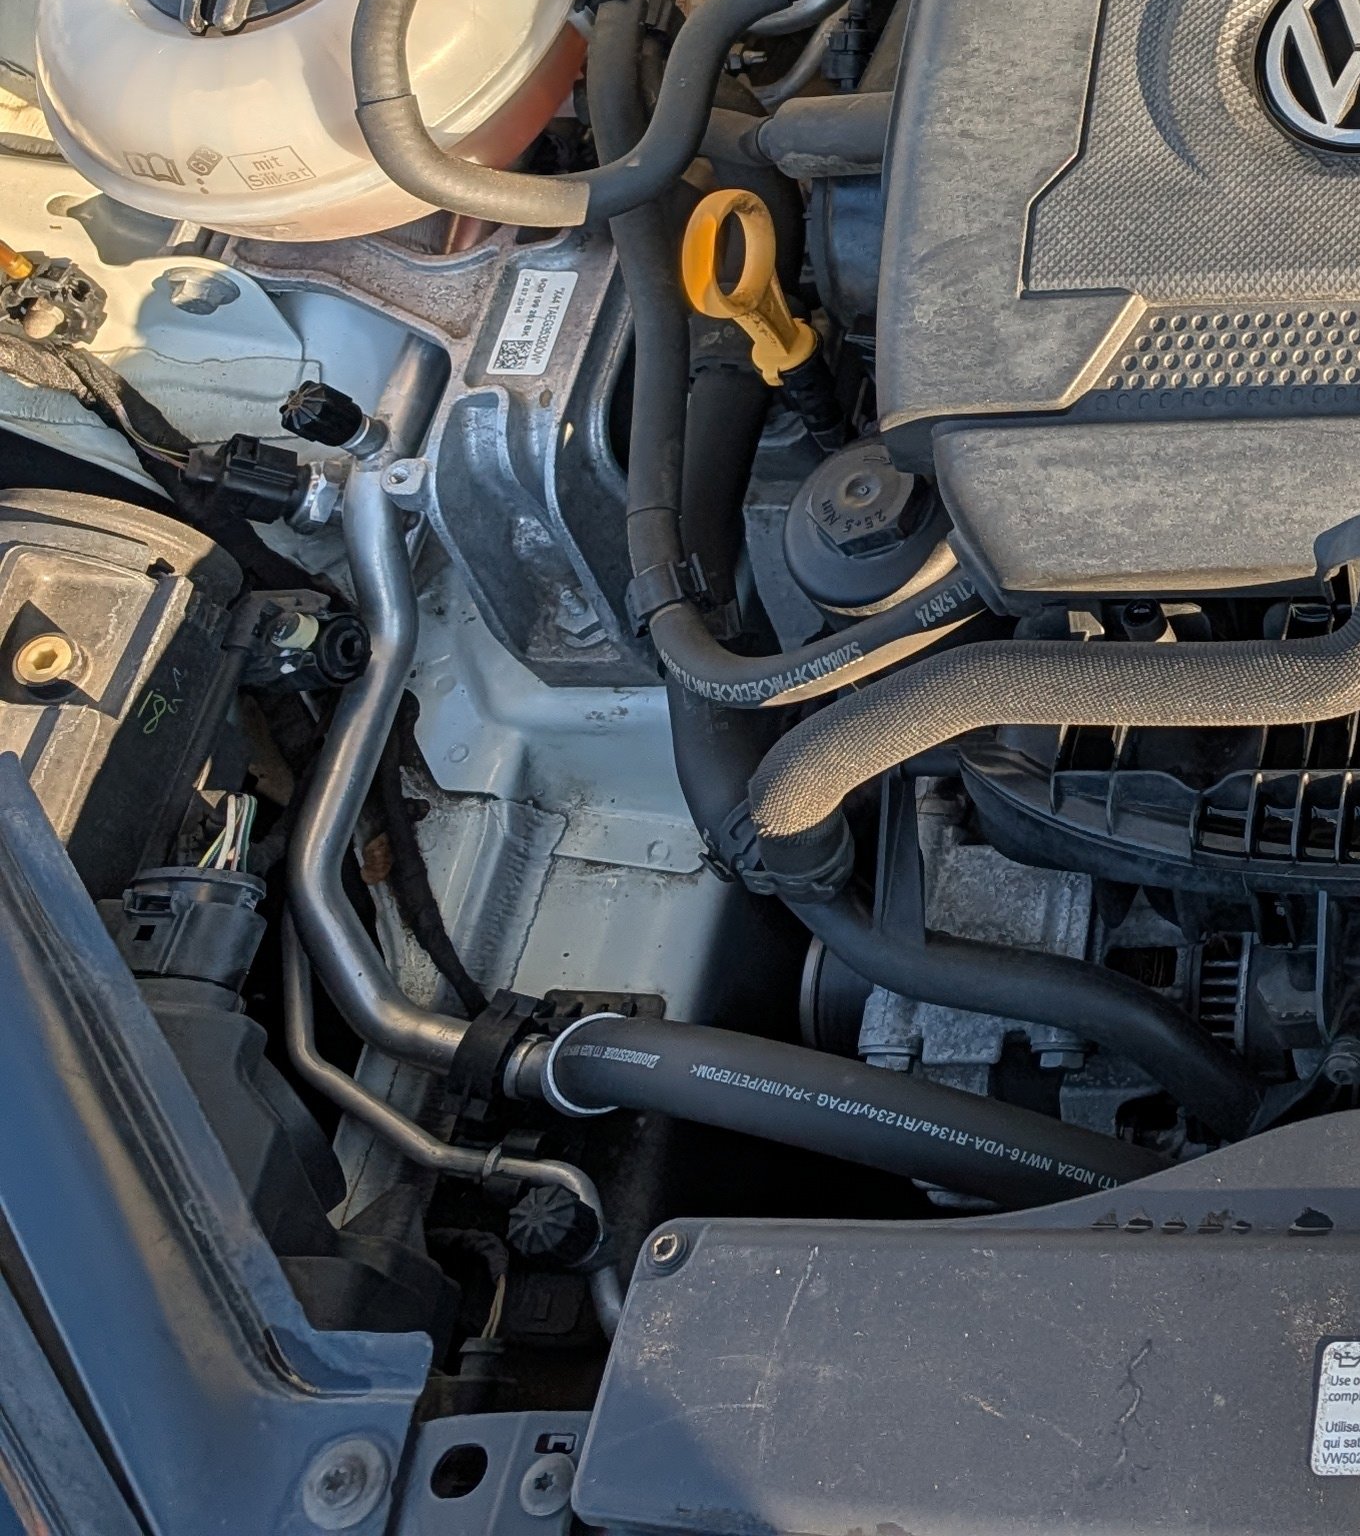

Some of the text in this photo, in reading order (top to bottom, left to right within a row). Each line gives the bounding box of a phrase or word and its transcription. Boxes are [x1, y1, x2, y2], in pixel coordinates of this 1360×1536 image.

[252, 155, 284, 171] mit
[247, 167, 310, 187] Silikat
[1331, 1375, 1350, 1386] Use
[1323, 1437, 1340, 1451] qui
